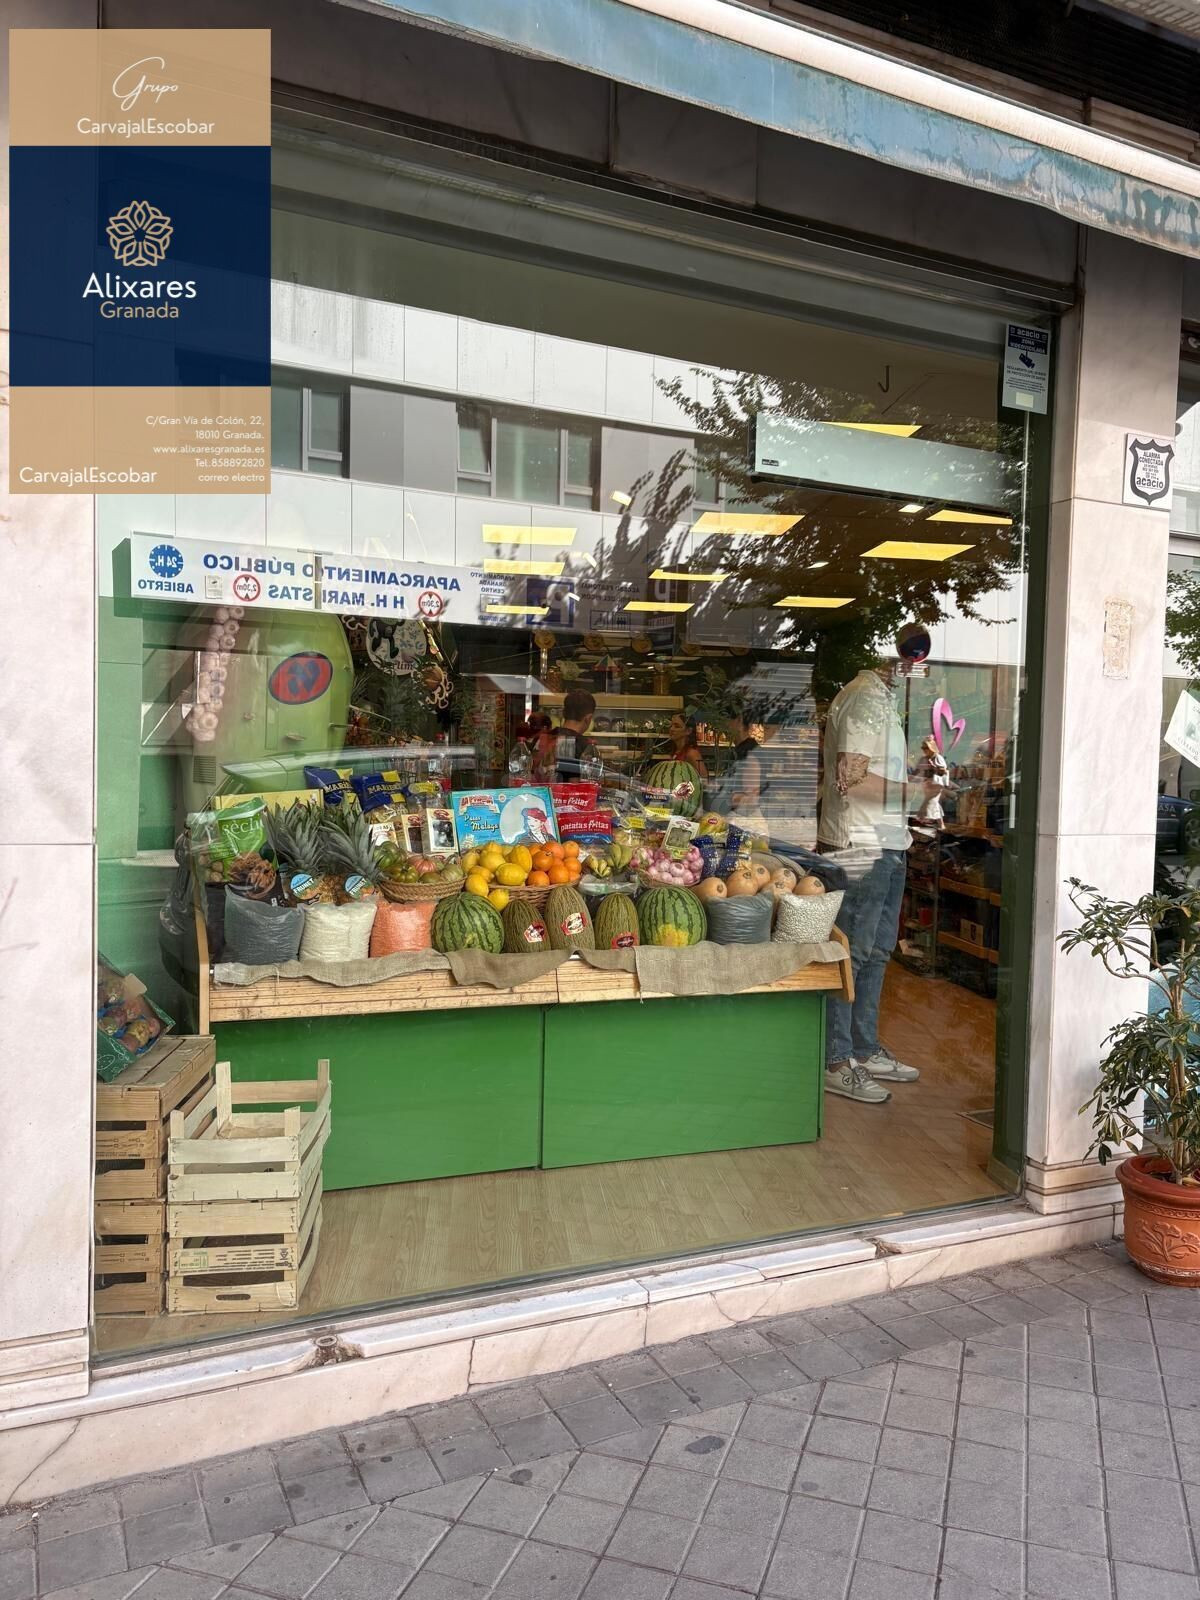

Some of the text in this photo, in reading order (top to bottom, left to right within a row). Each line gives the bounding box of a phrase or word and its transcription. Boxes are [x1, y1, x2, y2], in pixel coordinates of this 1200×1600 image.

[1136, 476, 1164, 489] acacio
[560, 819, 609, 832] patatas fritas
